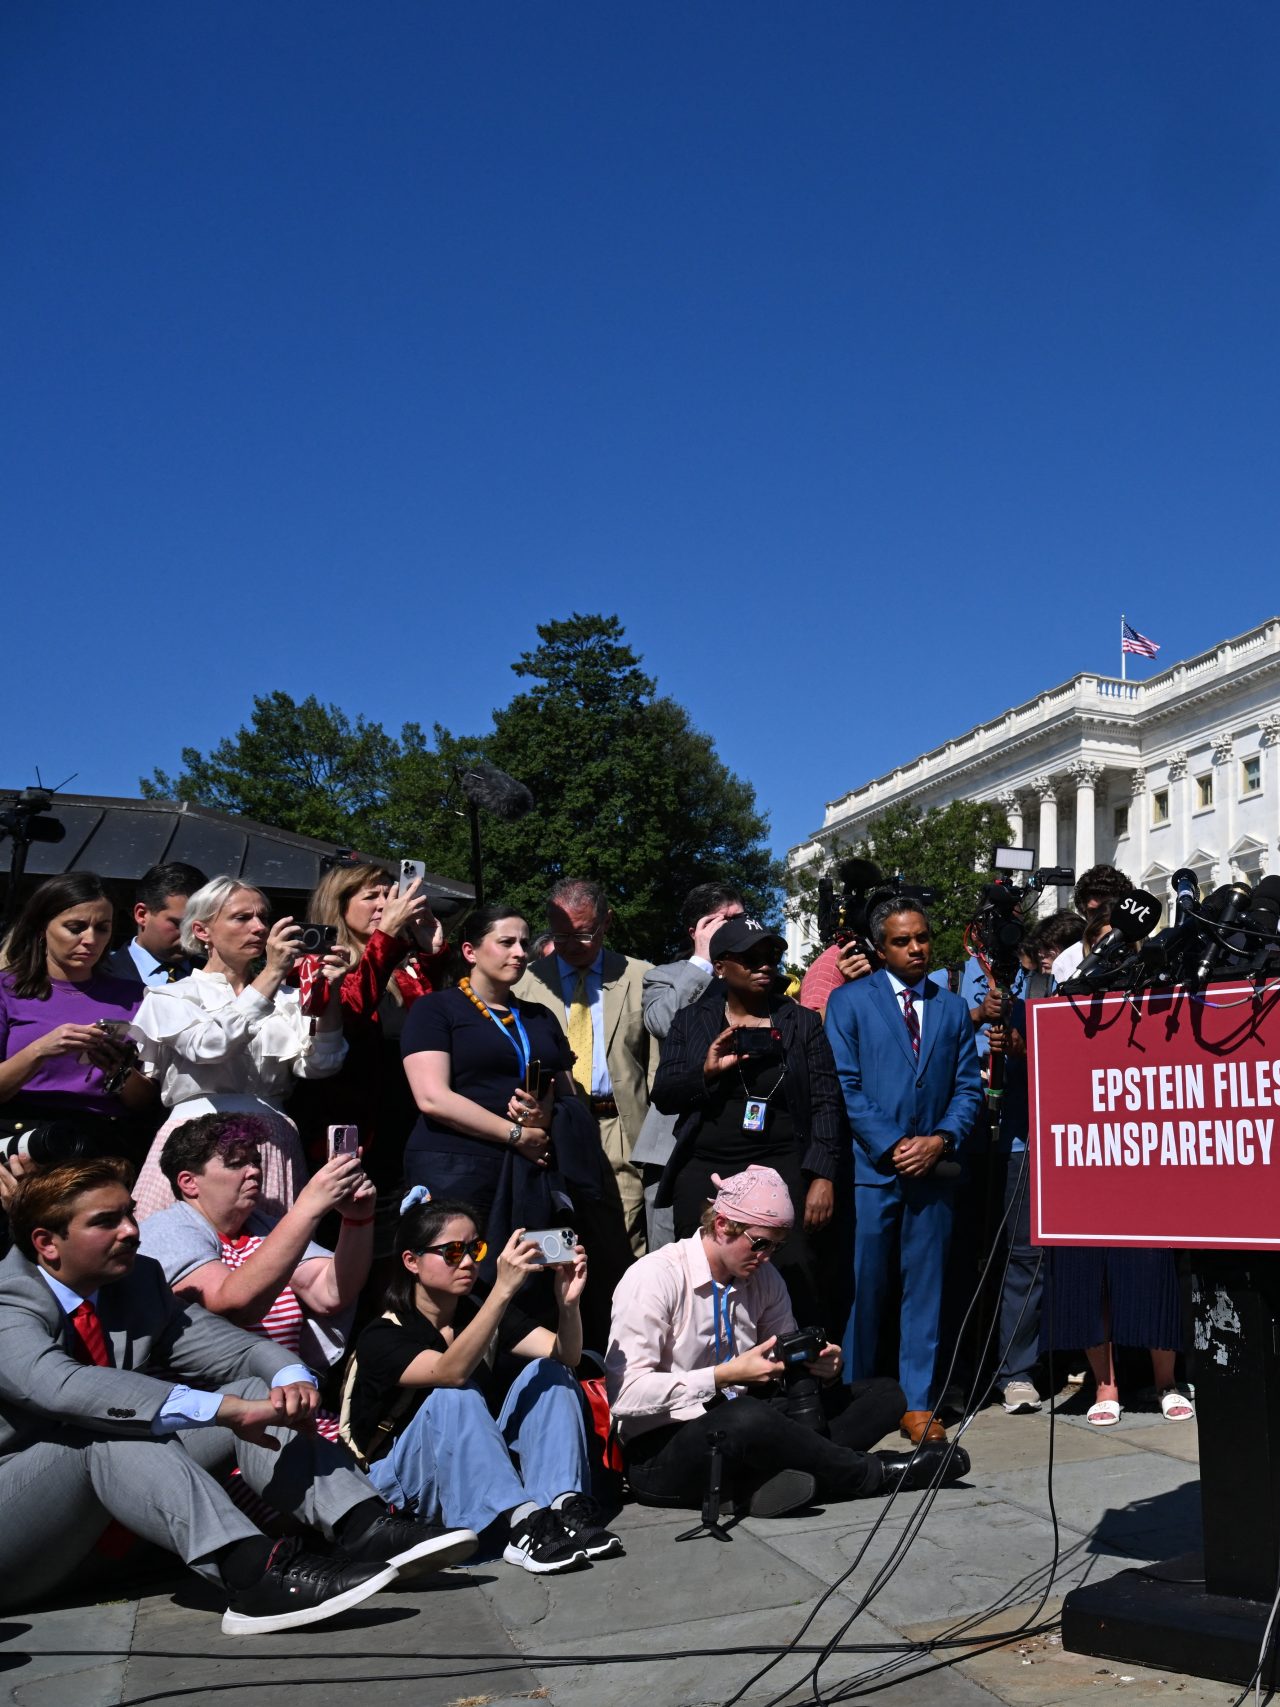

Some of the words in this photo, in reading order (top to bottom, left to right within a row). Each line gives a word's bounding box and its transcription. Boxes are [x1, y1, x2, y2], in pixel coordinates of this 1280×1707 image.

[1121, 898, 1150, 922] svt
[1092, 1065, 1204, 1111] EPSTEIN
[1051, 1119, 1274, 1166] TRANSPARENCY
